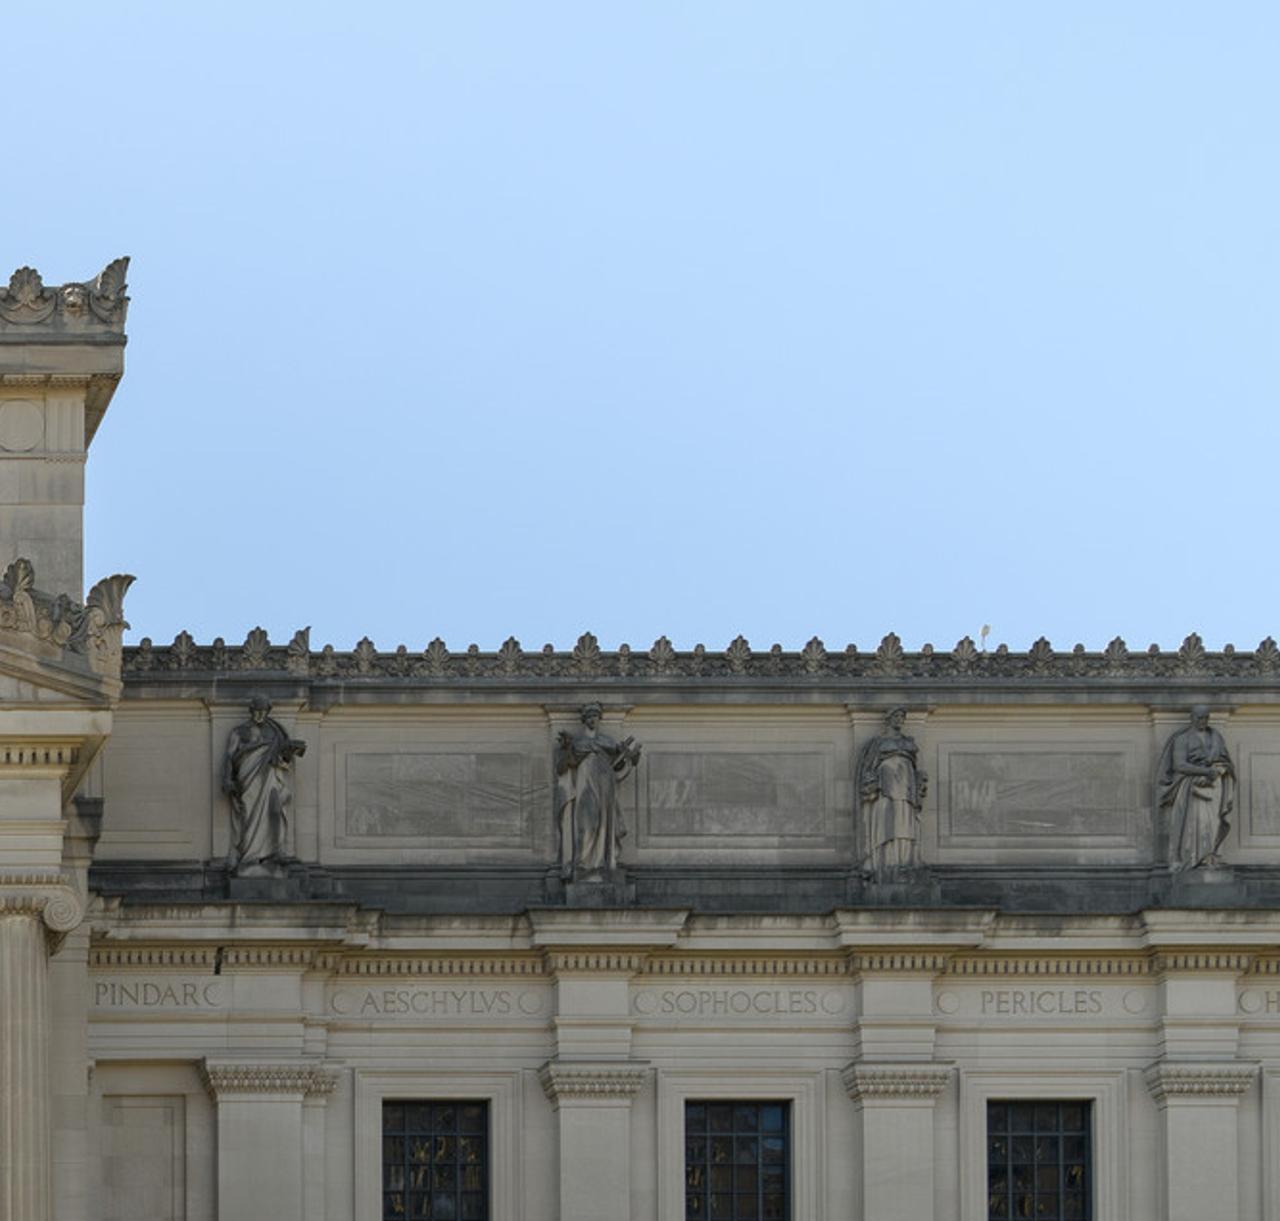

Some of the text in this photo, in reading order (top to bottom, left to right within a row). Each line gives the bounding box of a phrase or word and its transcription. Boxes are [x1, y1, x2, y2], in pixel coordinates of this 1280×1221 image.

[95, 982, 199, 1006] PINDAR
[360, 990, 512, 1014] AESCHYLVS
[661, 990, 817, 1015] SOPHOCLES
[980, 990, 1103, 1015] PERICLES
